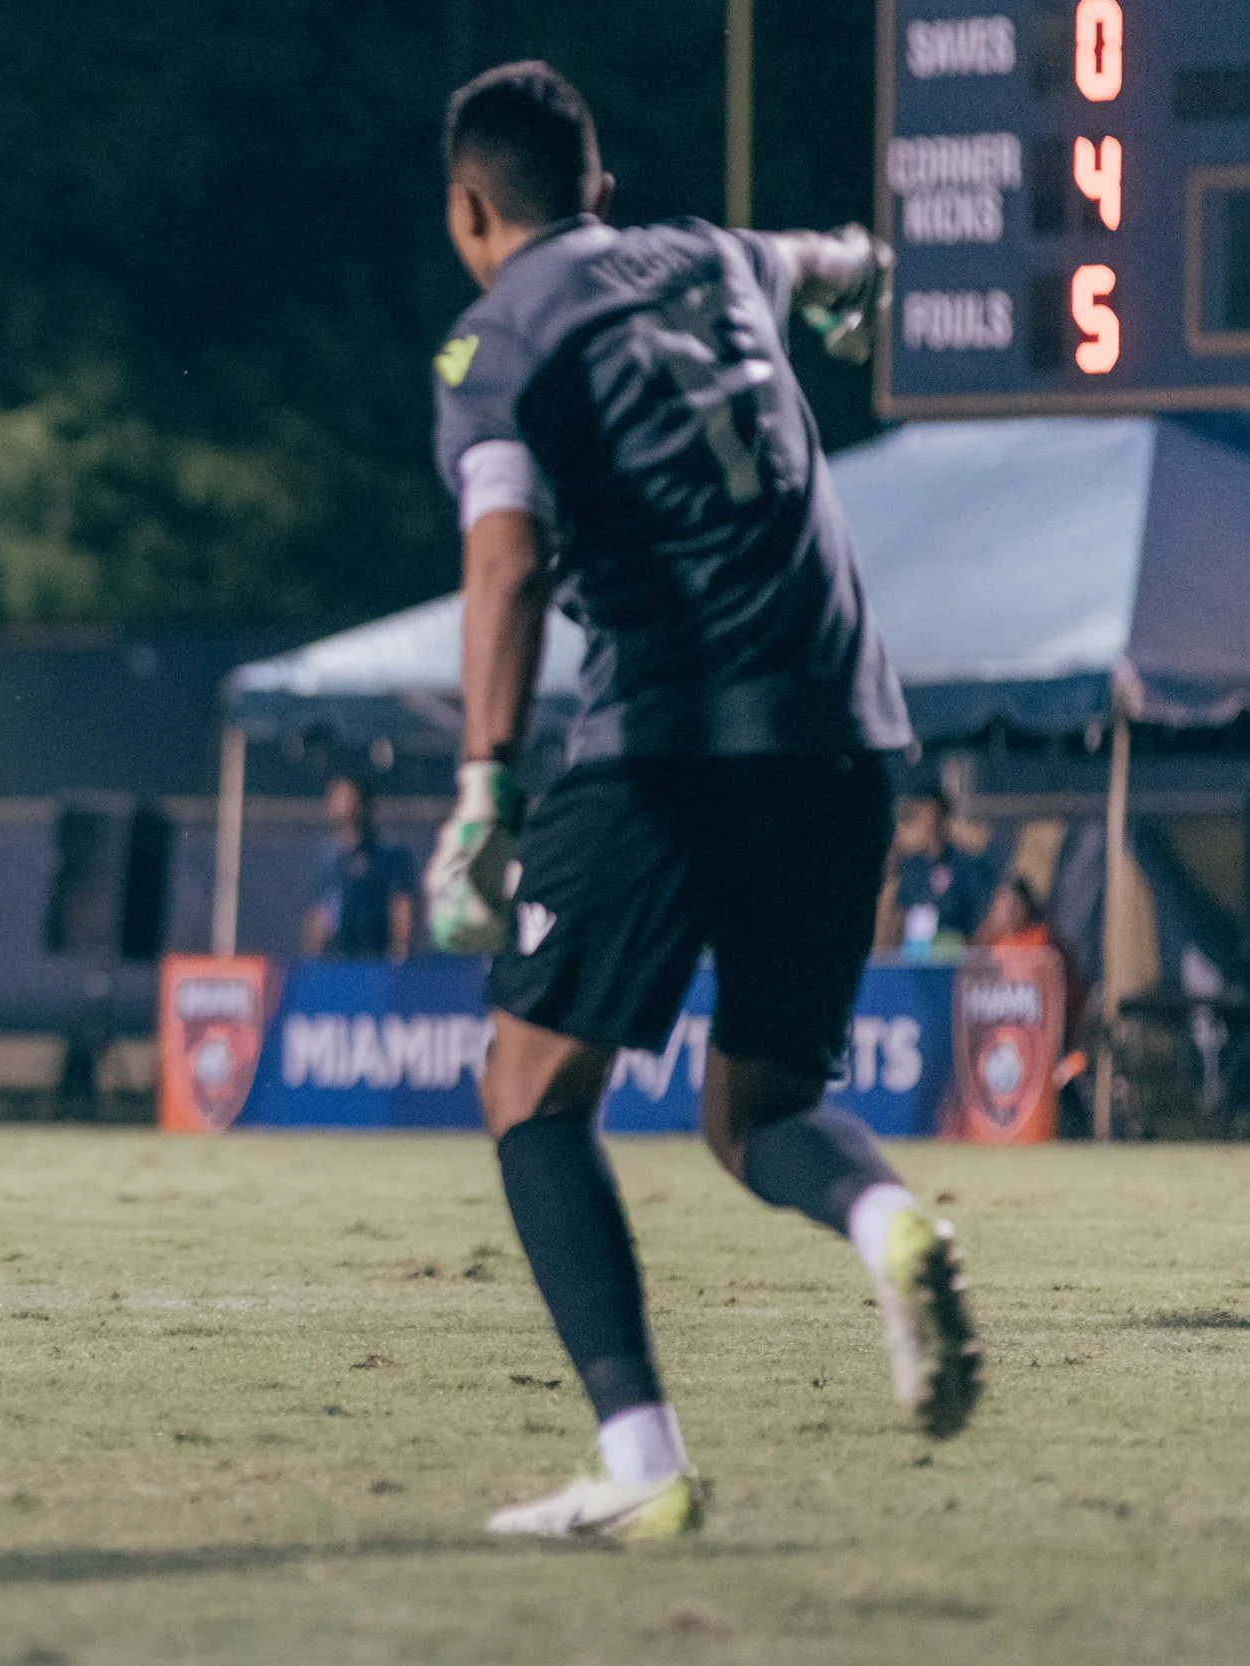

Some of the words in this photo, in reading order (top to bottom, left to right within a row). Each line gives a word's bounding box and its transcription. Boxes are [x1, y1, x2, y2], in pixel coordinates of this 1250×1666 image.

[1075, 0, 1123, 101] 0
[1074, 136, 1122, 231] 4
[903, 290, 1013, 349] FOULS
[1072, 264, 1120, 373] 5
